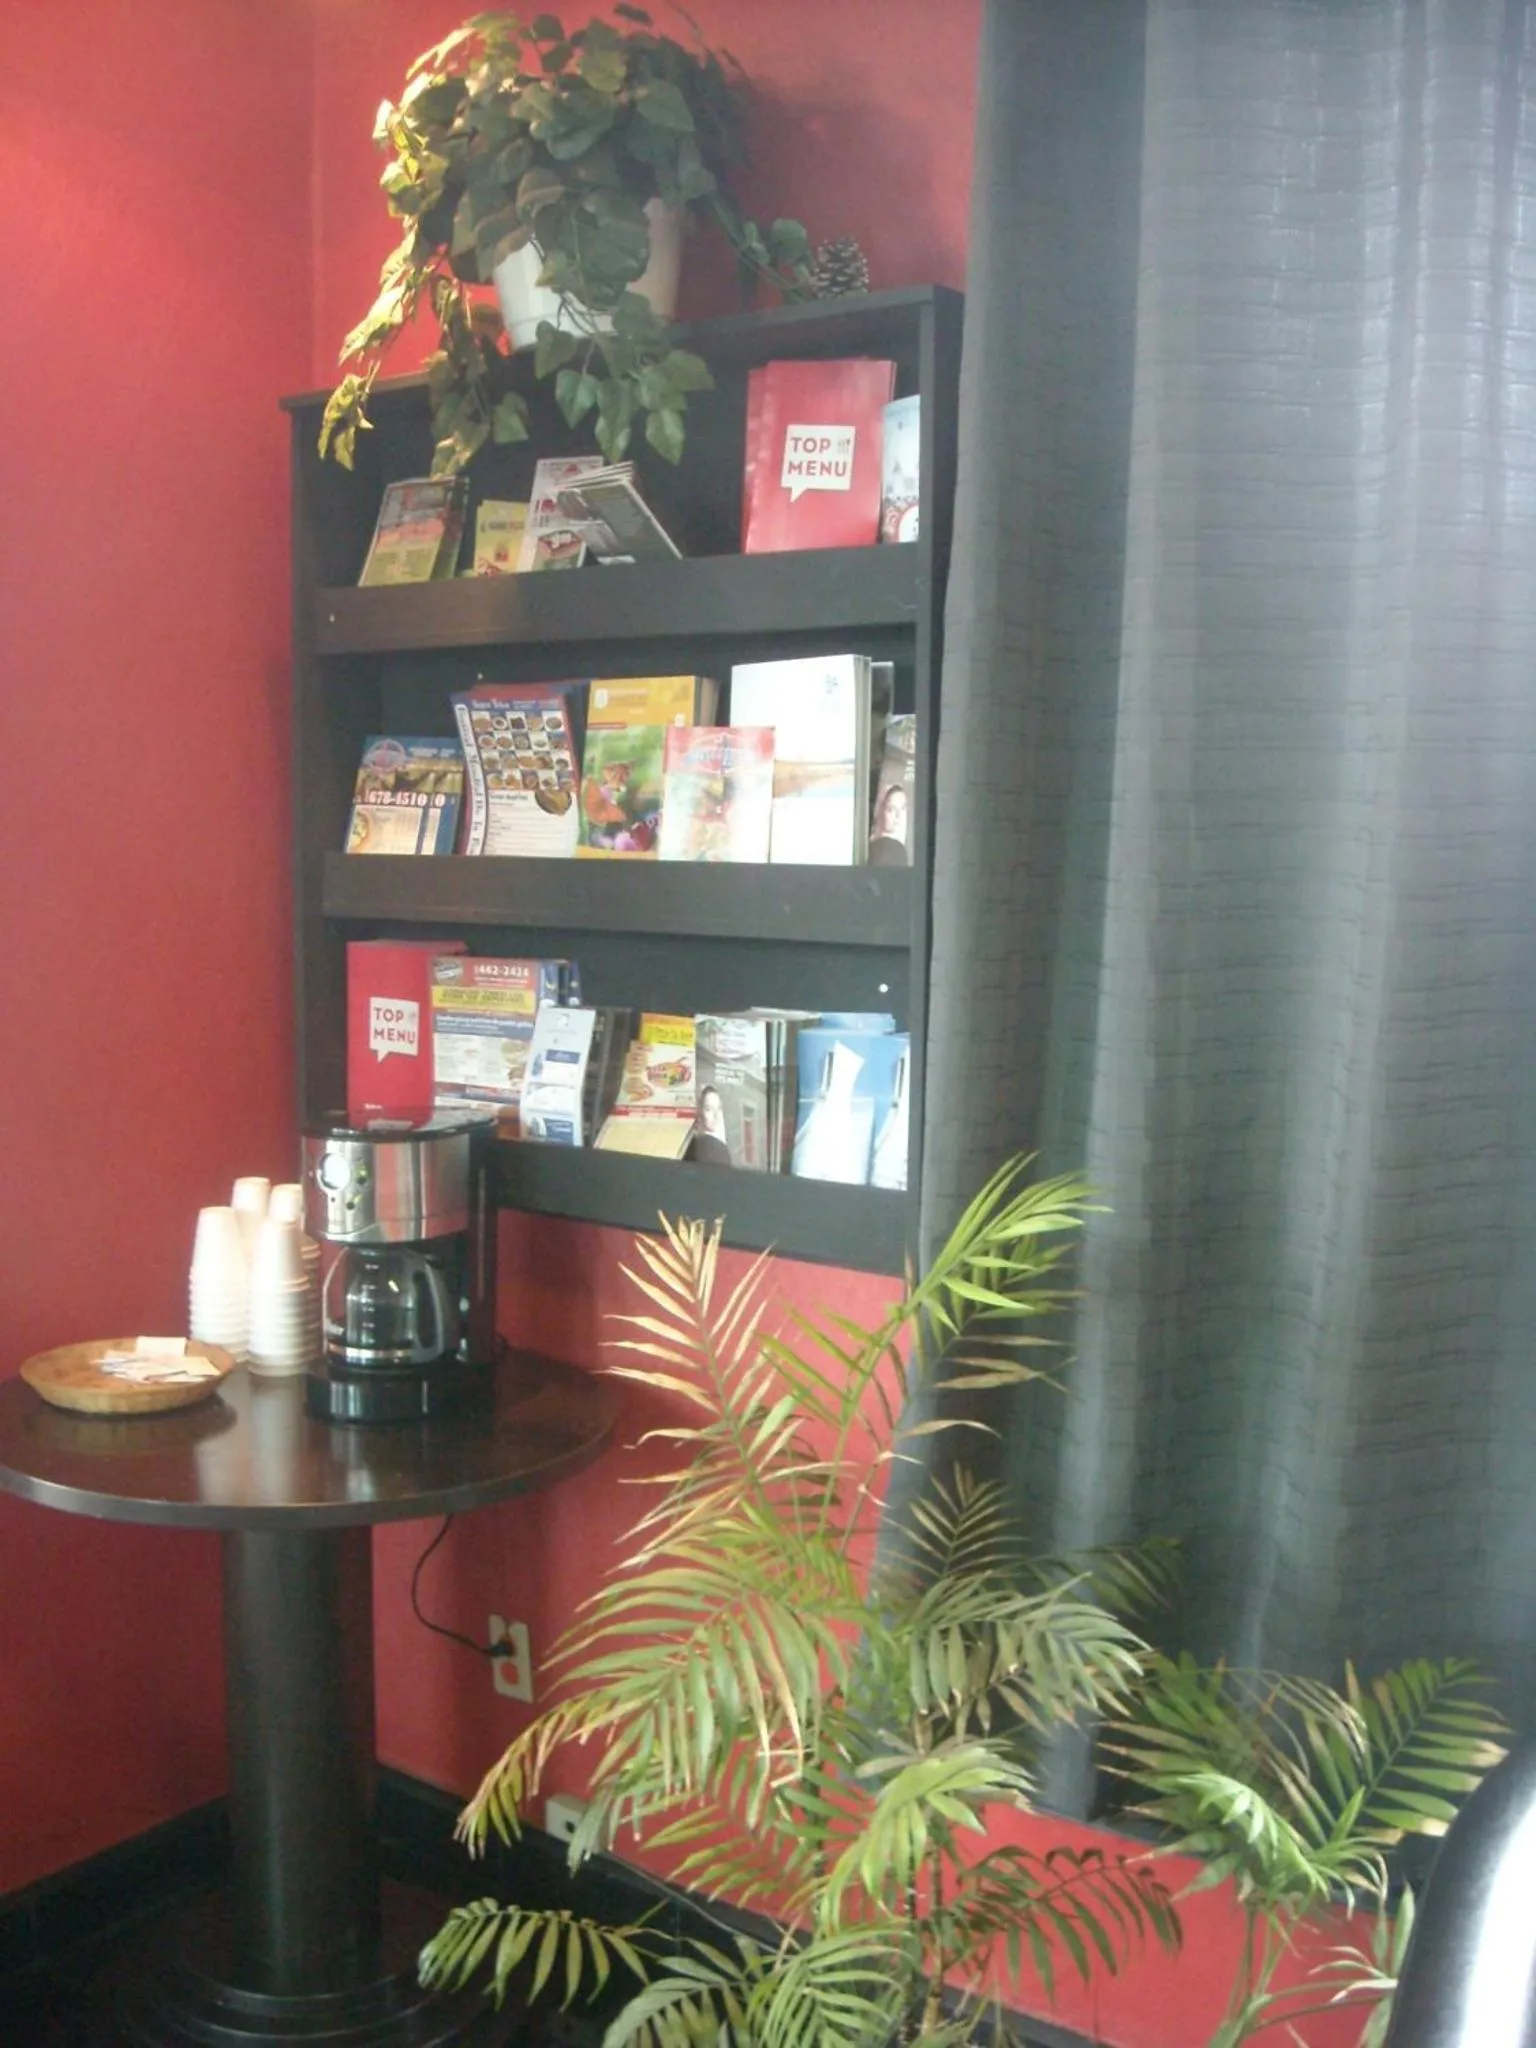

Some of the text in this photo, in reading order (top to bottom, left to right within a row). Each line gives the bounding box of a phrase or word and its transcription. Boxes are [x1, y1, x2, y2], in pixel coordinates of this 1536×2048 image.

[790, 437, 831, 453] TOP
[787, 460, 847, 477] MENU
[373, 1006, 404, 1023] TOP
[373, 1027, 417, 1046] MENU
